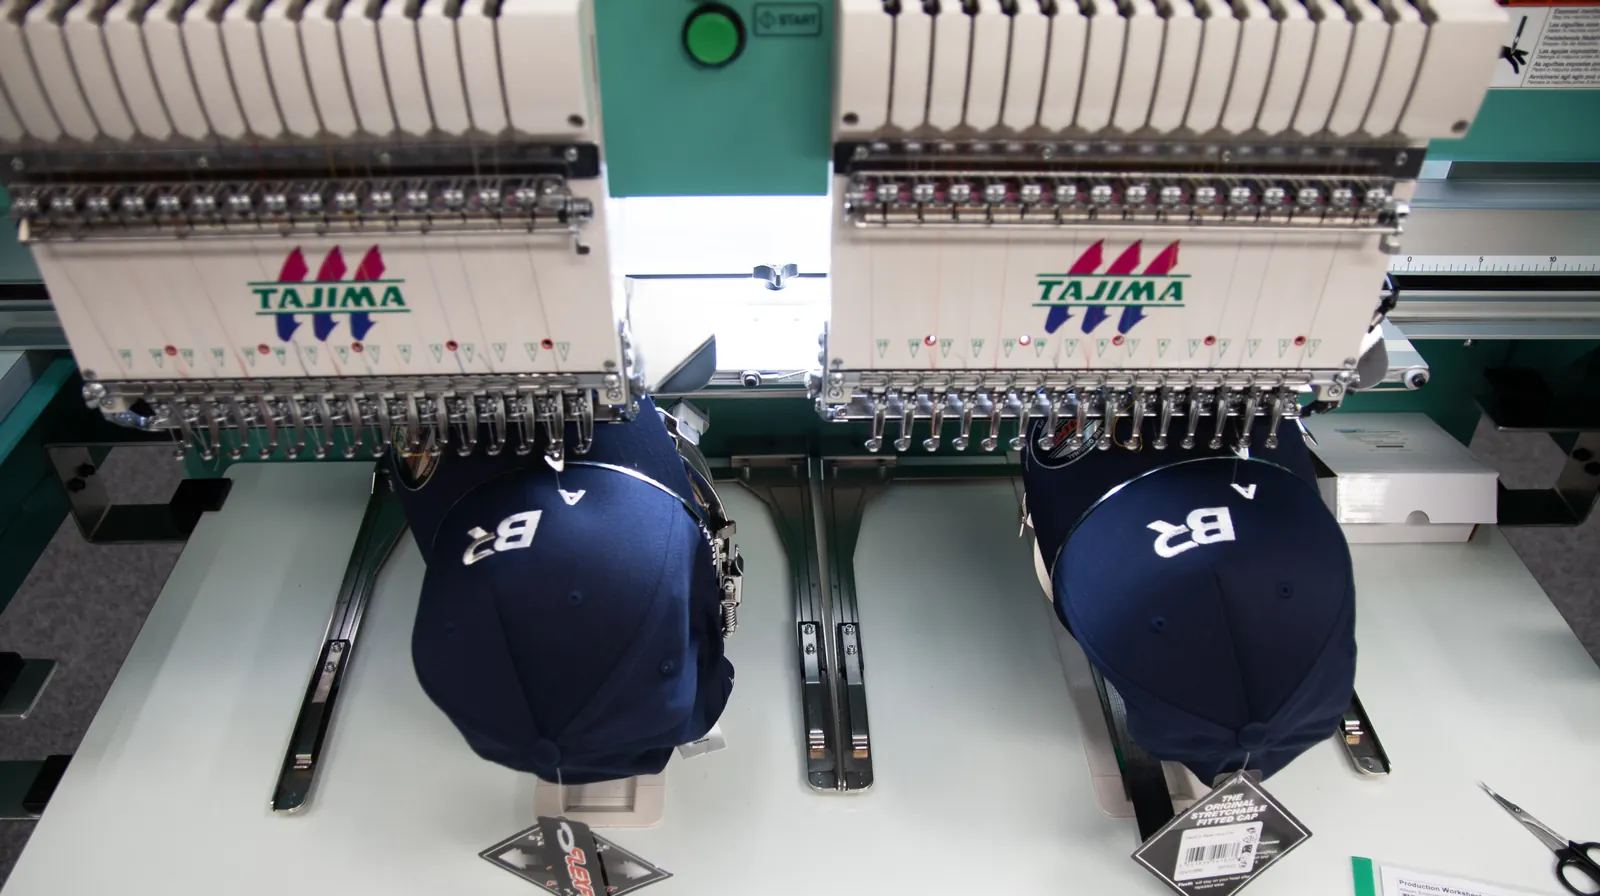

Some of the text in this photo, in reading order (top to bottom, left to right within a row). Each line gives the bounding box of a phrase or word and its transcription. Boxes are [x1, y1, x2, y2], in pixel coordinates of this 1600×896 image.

[779, 13, 818, 26] START
[252, 285, 406, 310] TAJIMA
[1037, 280, 1183, 301] TAJIMA
[558, 489, 586, 506] A
[462, 509, 543, 566] BR
[1146, 506, 1236, 558] BR
[1204, 799, 1255, 812] ORIGINAL
[1222, 793, 1244, 802] THE
[1190, 804, 1268, 820] STRETCHABLE
[1196, 813, 1259, 827] FITTED CAP
[1399, 880, 1440, 892] Production
